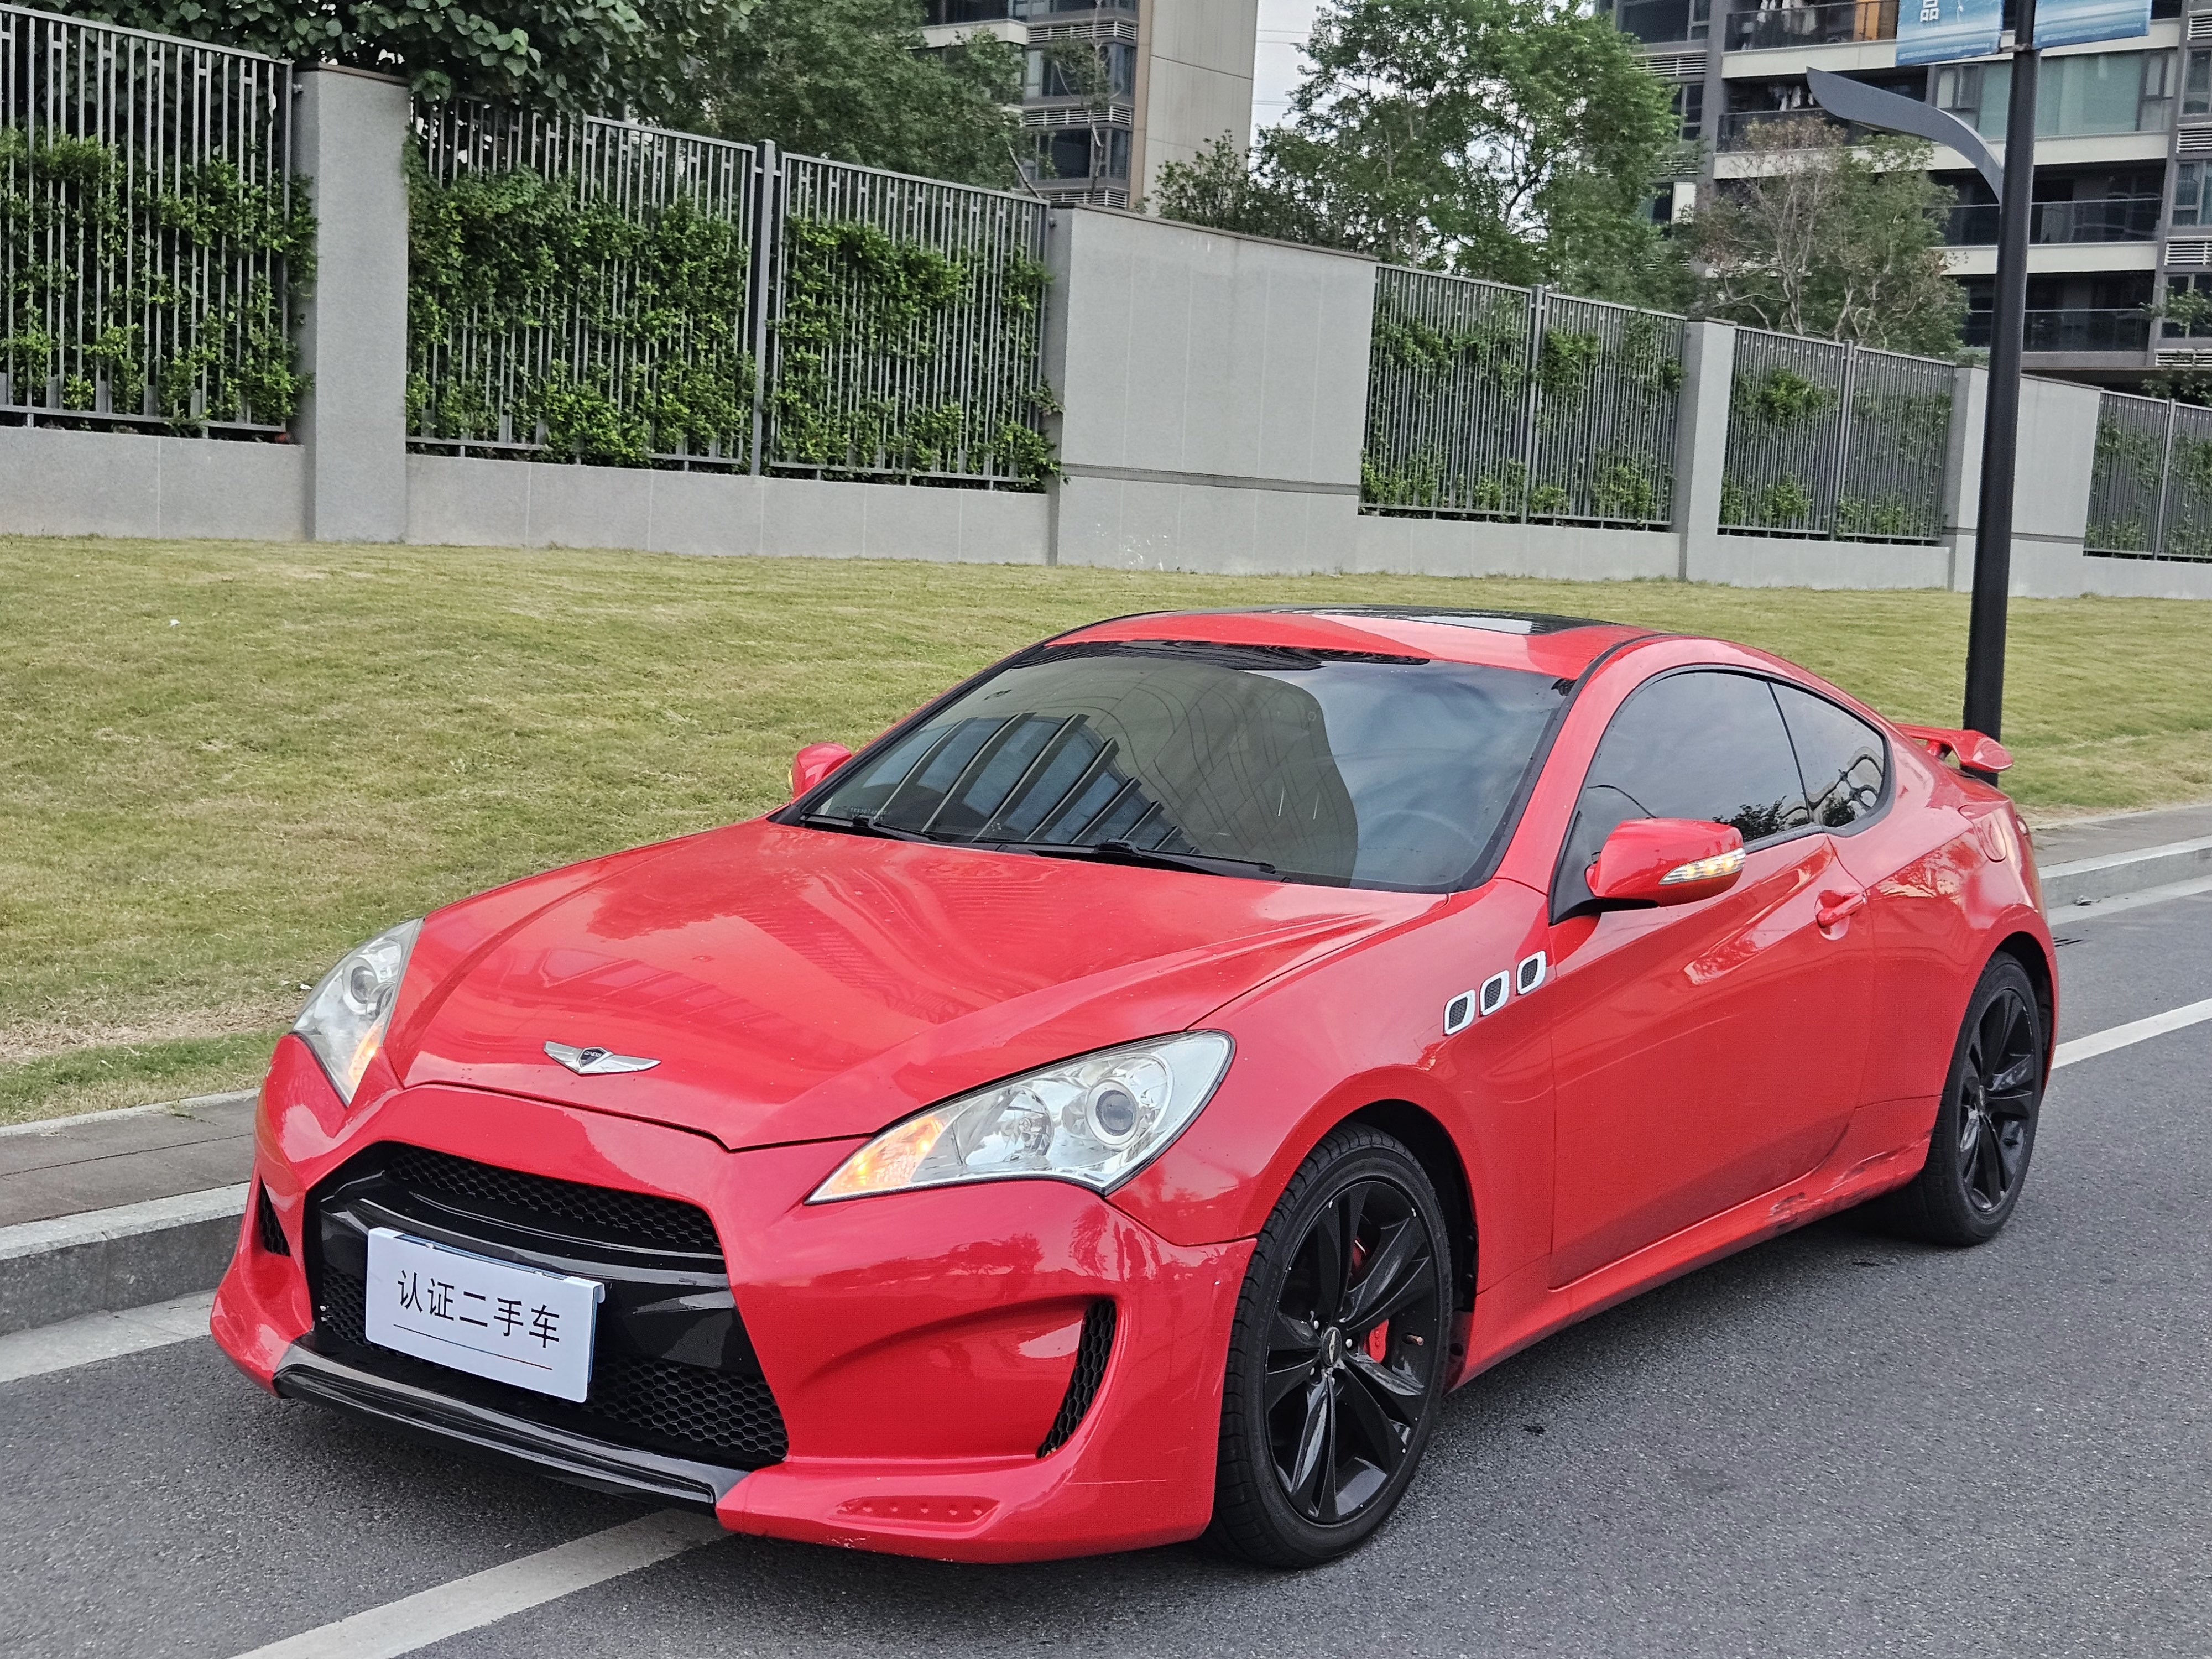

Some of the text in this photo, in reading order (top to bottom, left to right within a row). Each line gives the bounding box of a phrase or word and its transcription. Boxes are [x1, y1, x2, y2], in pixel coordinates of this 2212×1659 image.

[398, 1270, 560, 1349] 认证二手车
